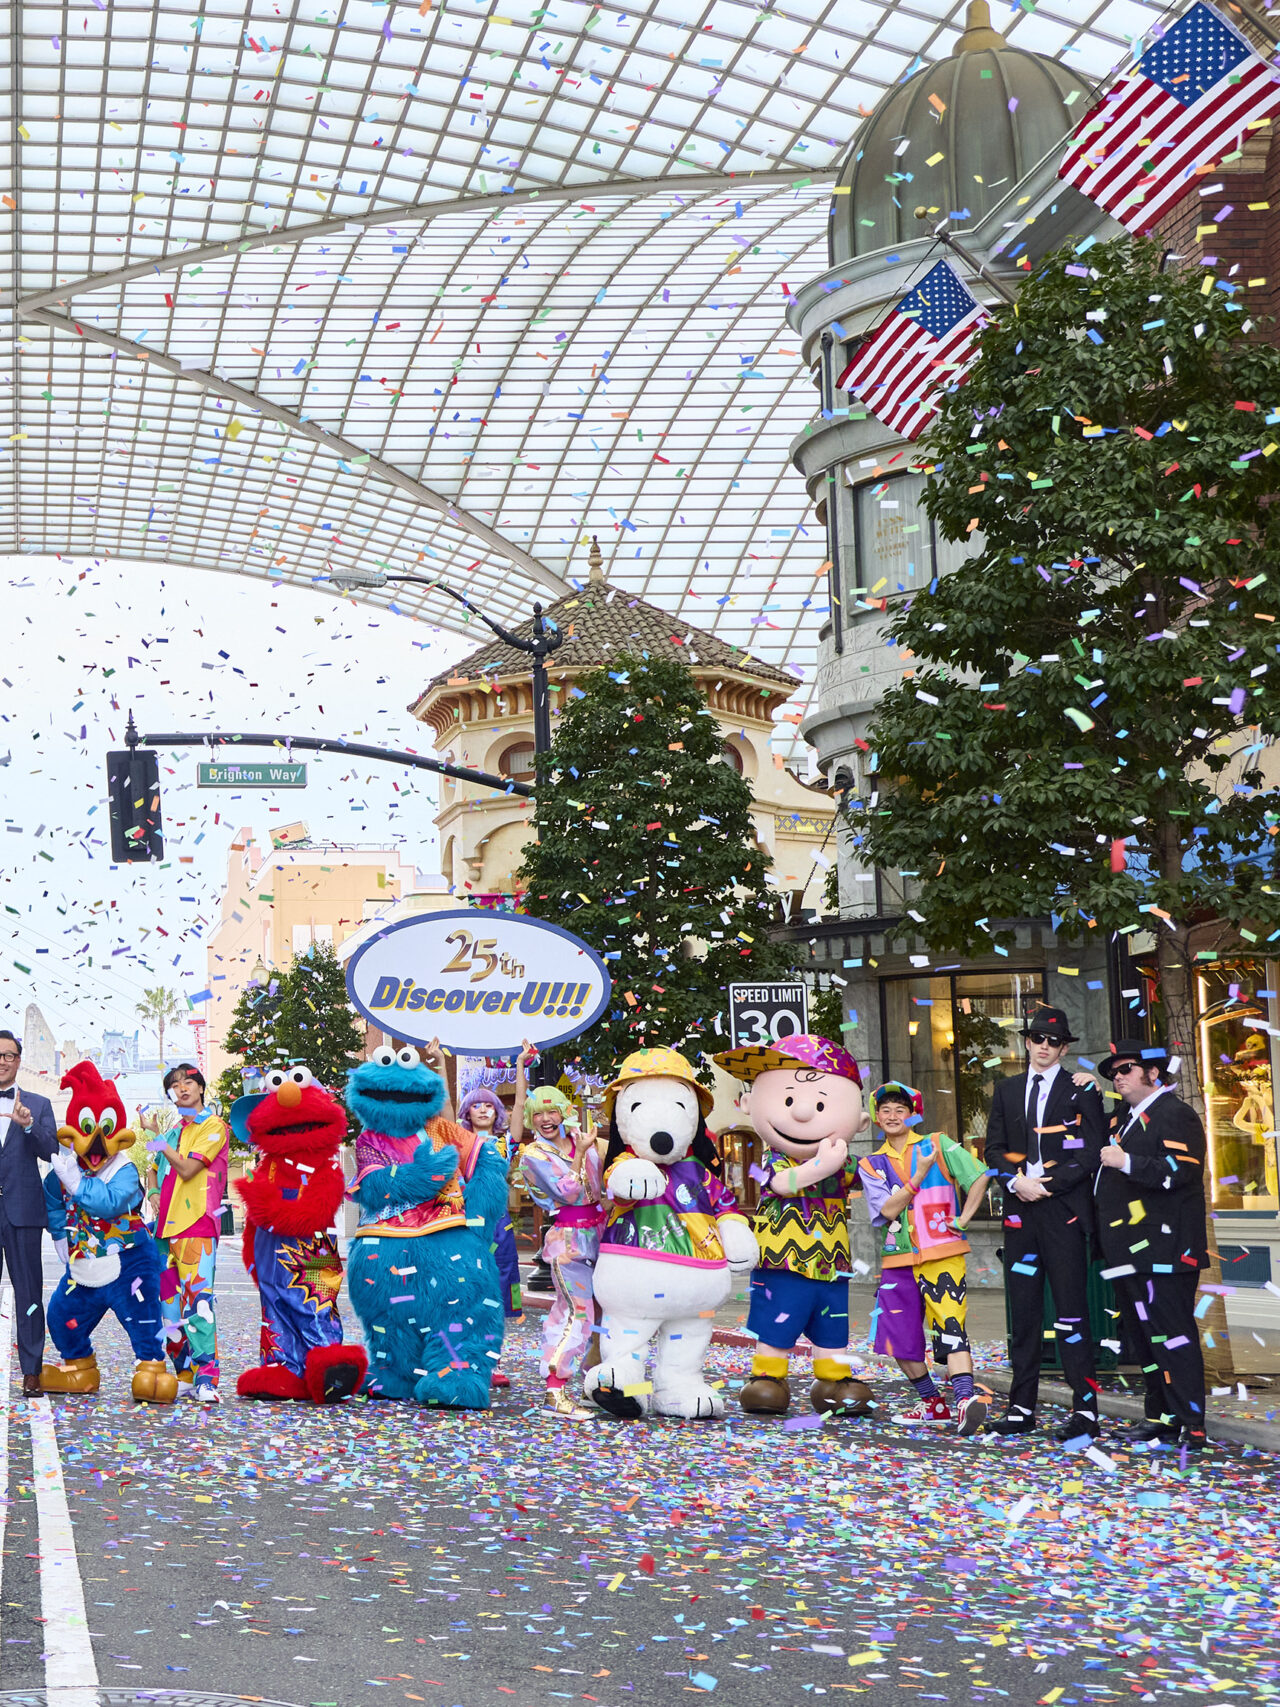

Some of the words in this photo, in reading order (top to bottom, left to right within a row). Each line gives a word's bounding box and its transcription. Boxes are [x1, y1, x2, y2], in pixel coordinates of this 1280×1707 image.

[209, 769, 262, 782] Brighton
[269, 769, 297, 782] Way
[440, 929, 526, 983] 25th
[369, 976, 592, 1019] DiscoverU!!!
[733, 988, 769, 1003] SPEED
[772, 988, 802, 1003] LIMIT
[738, 1009, 802, 1047] 30
